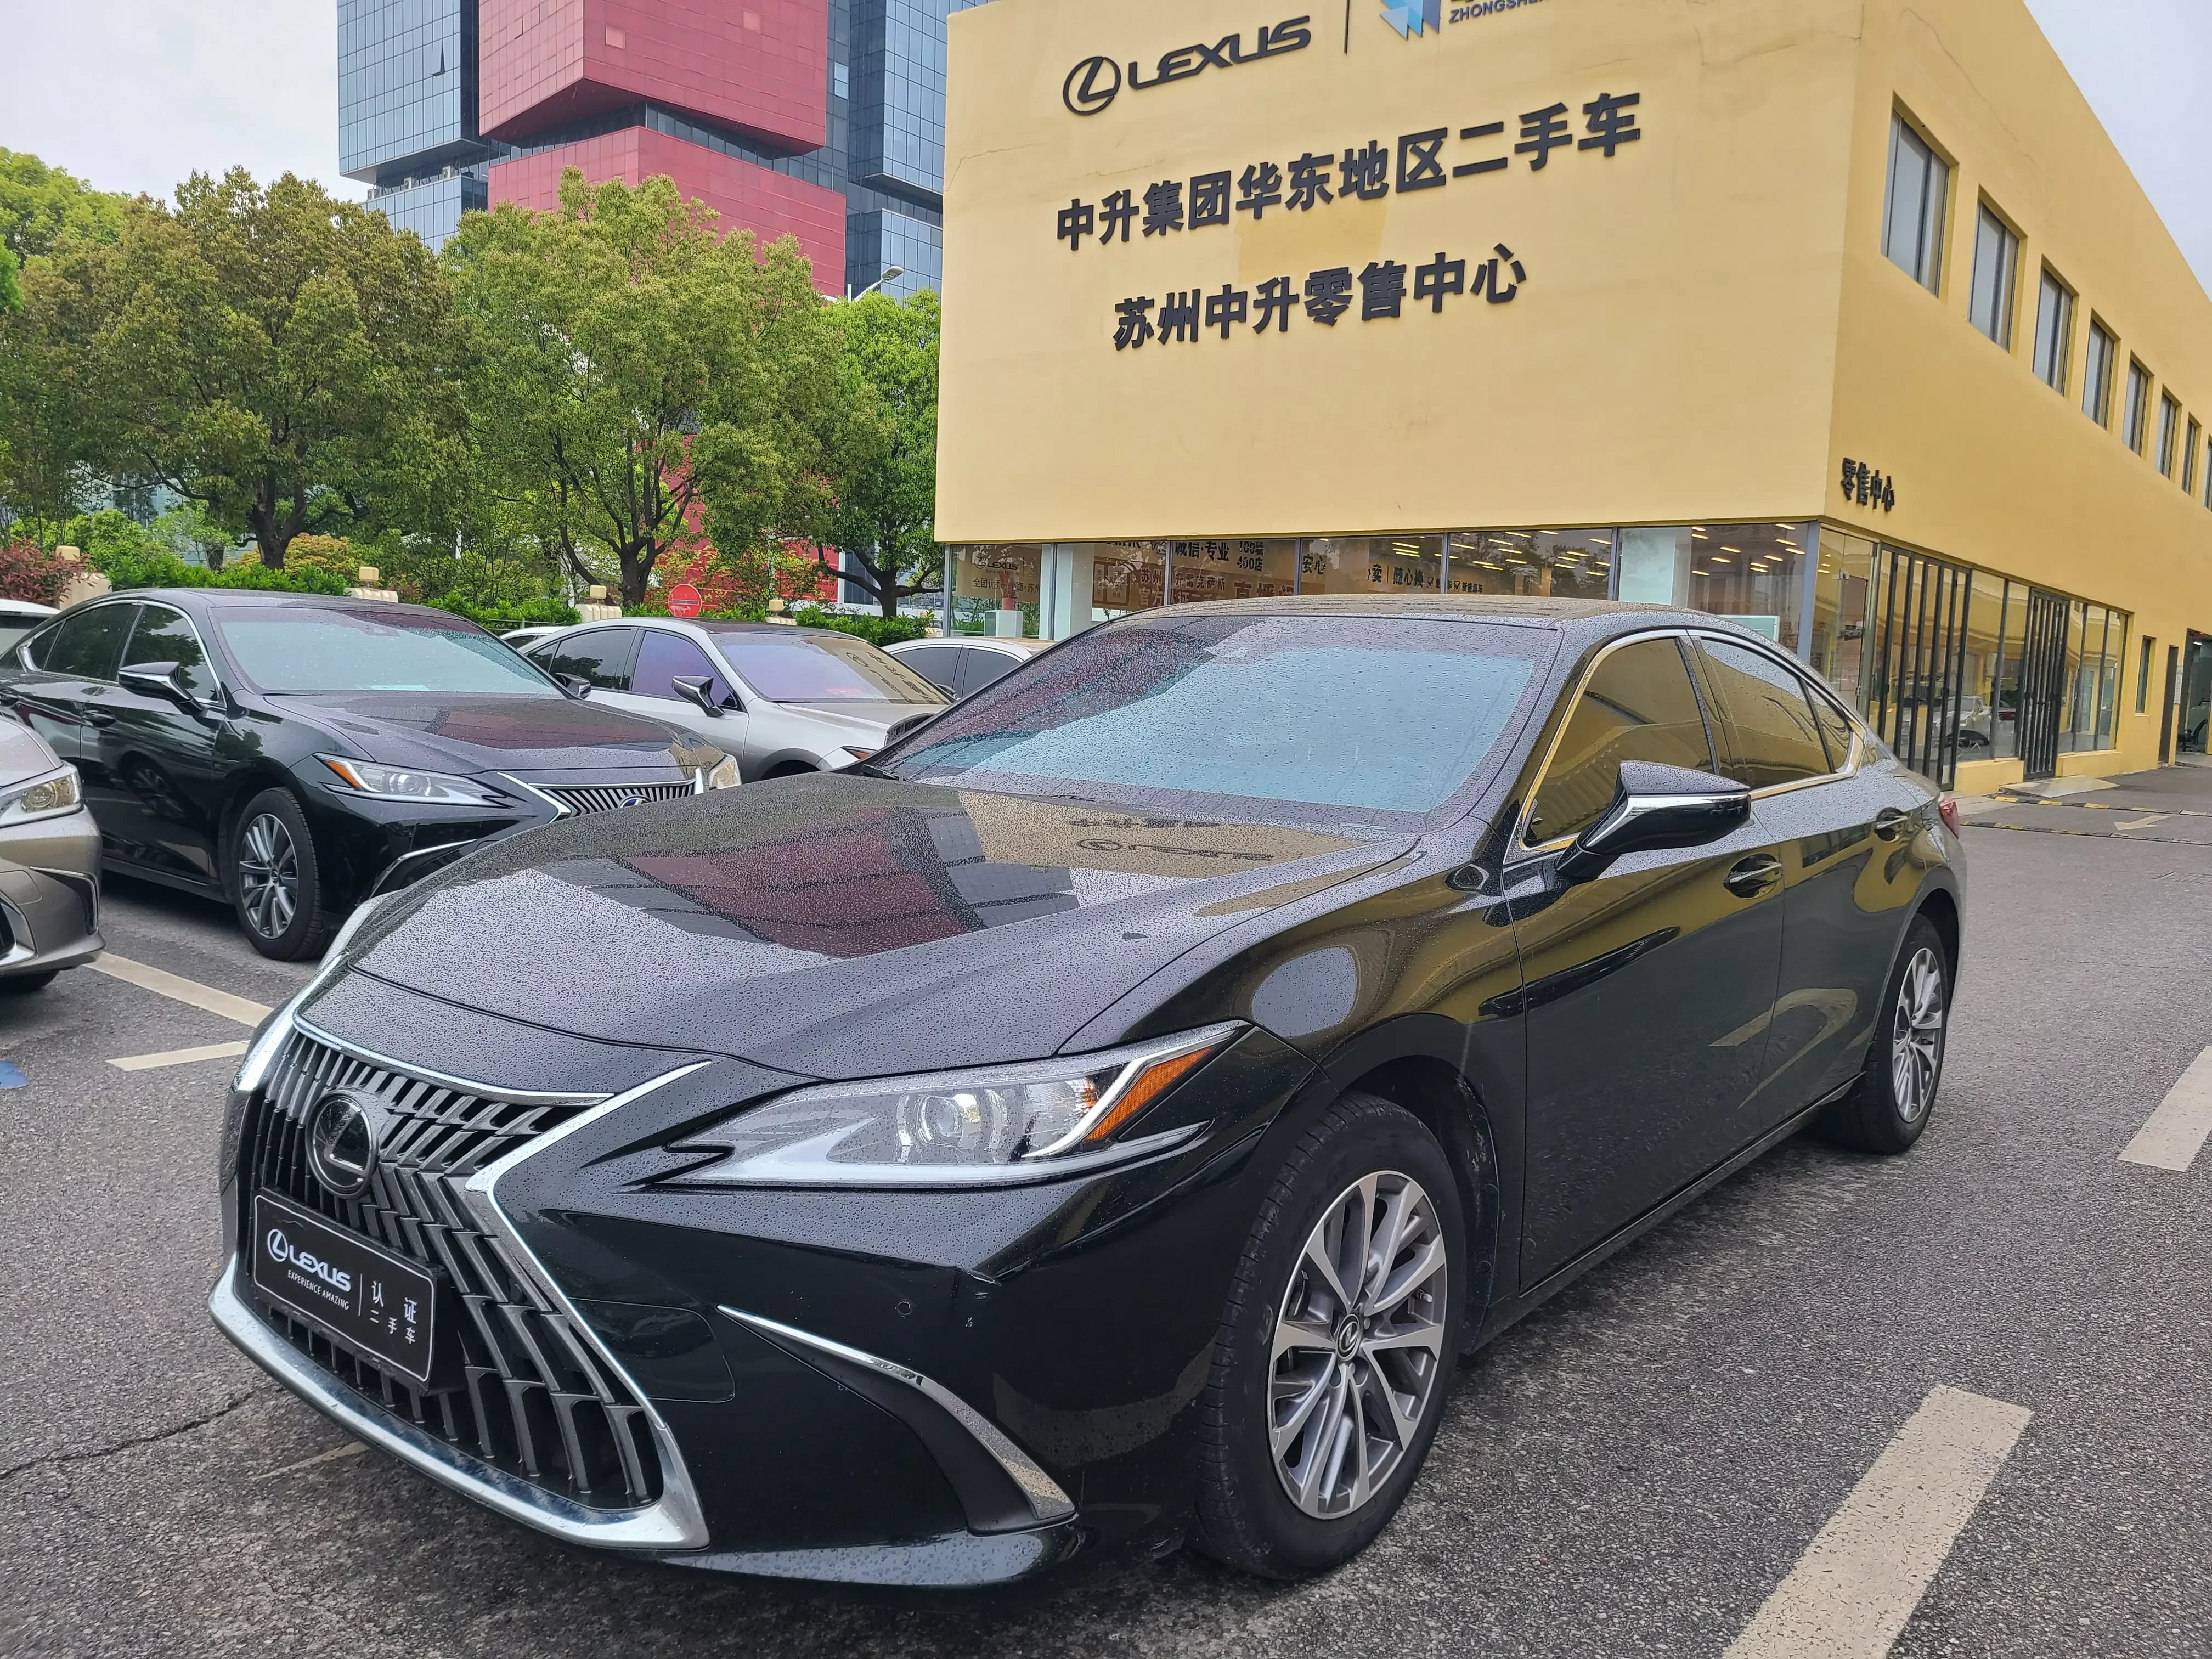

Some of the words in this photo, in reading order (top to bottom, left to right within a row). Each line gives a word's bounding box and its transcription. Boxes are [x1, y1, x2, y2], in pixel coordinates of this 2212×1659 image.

[1449, 0, 1549, 24] ZHONGSH
[1128, 15, 1311, 89] LEXUS
[1057, 92, 1641, 251] 中升集团华东地区二手车
[1113, 242, 1527, 351] 苏州中升零售中心
[1840, 458, 1895, 512] 零售中心
[988, 562, 1018, 571] LEXUS
[287, 1269, 321, 1295] EXPERIENCE
[322, 1290, 350, 1310] AMAZING
[290, 1245, 351, 1292] LEXUS
[370, 1310, 415, 1345] 二手车
